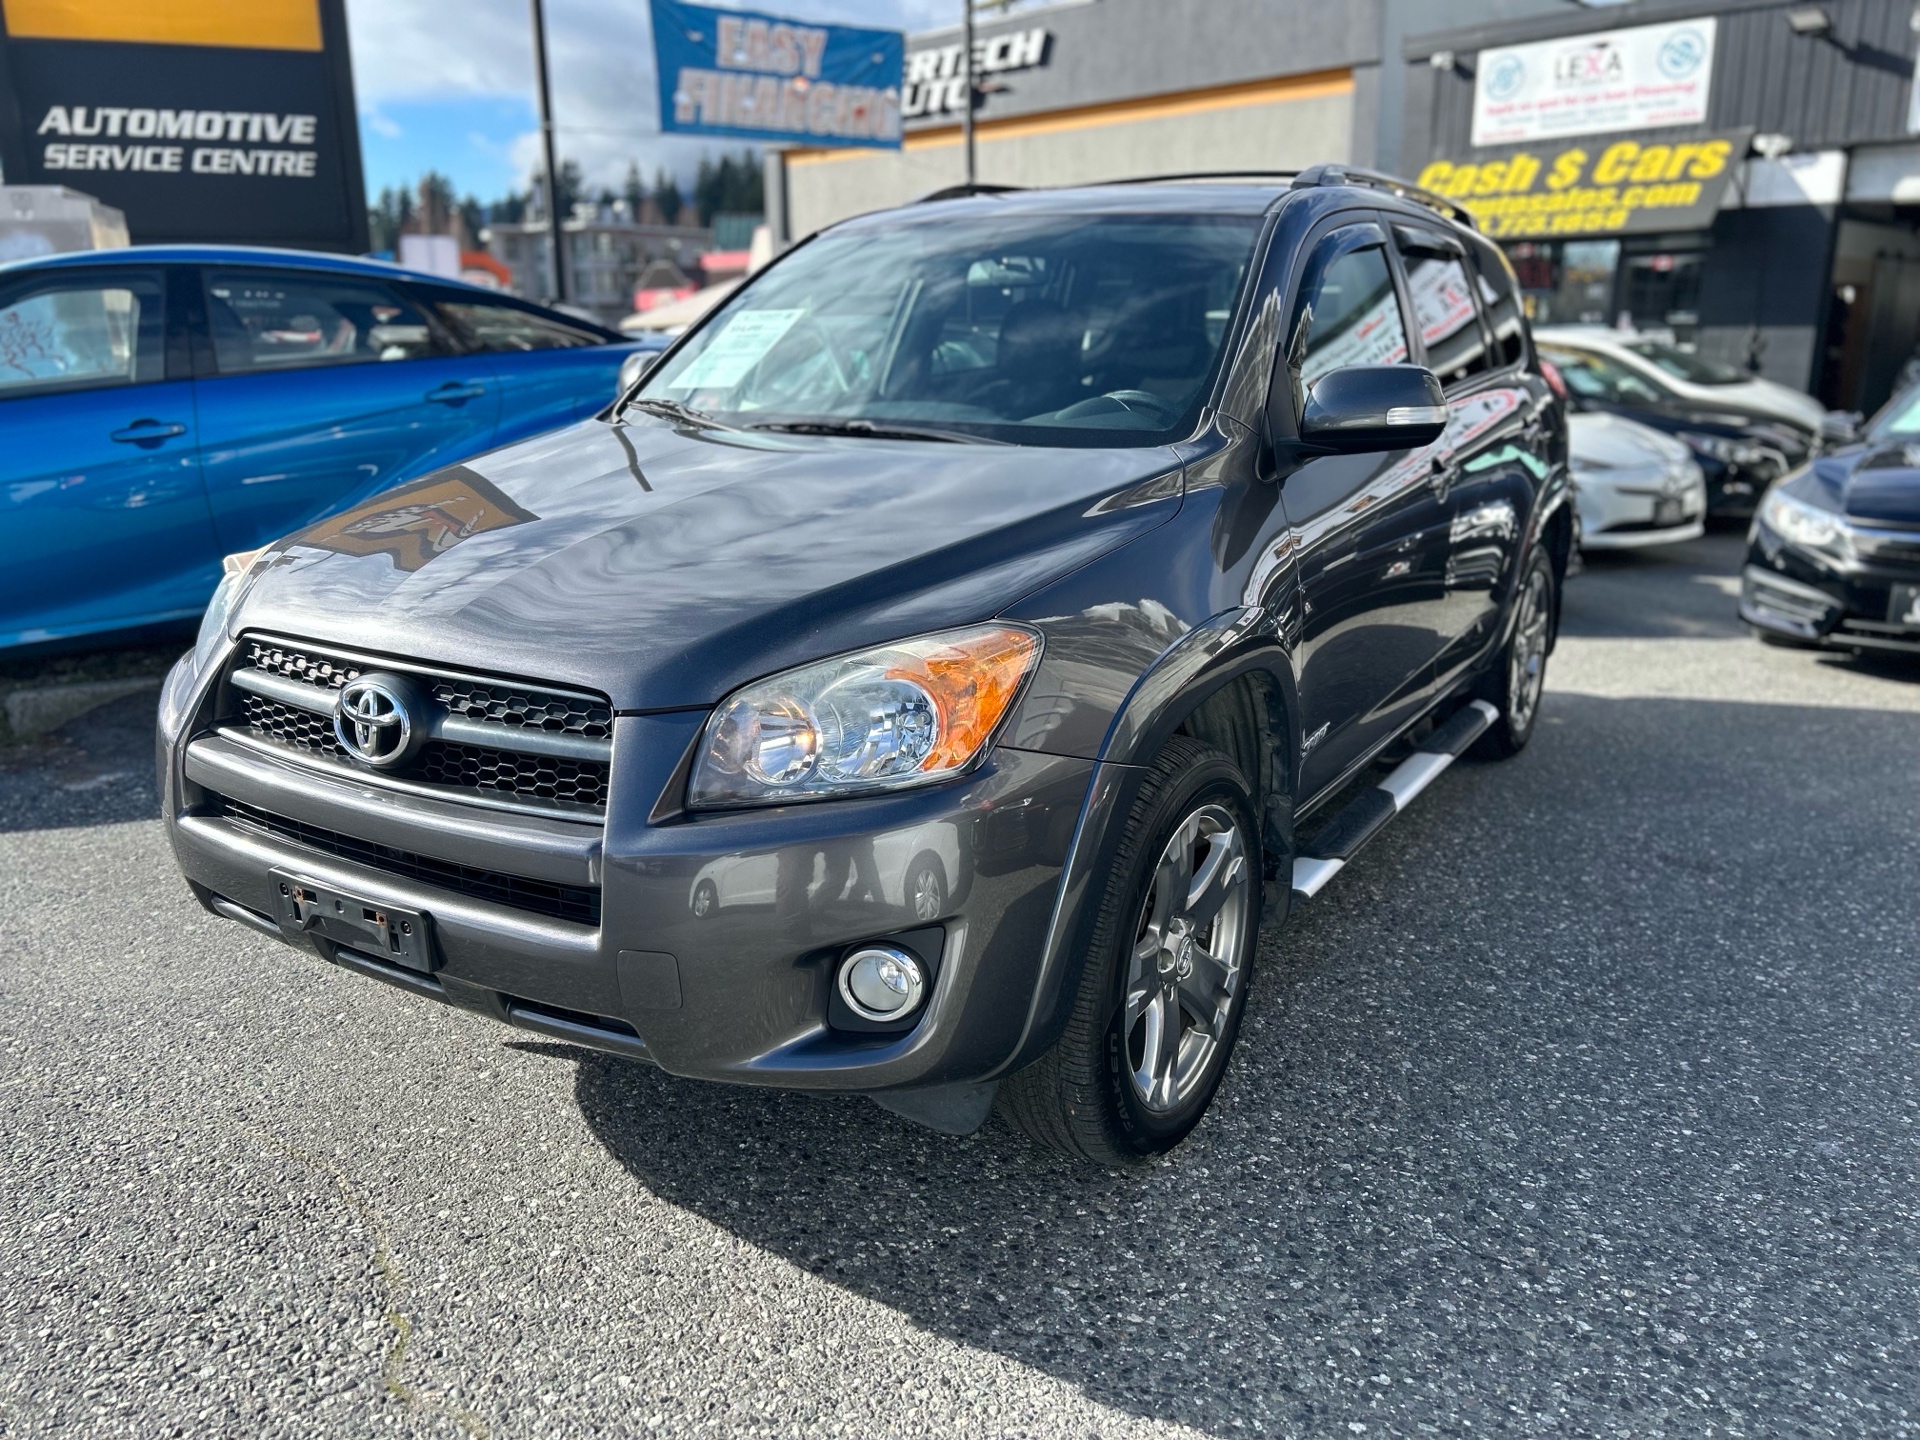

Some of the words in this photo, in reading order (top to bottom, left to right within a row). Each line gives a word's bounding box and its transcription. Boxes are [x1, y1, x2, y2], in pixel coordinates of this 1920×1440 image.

[716, 16, 828, 78] EASY
[904, 29, 1045, 84] RTECH
[1554, 50, 1623, 80] LEXA
[901, 78, 971, 117] UTO
[37, 105, 318, 144] AUTOMOTIVE
[43, 143, 184, 172] SERVICE
[190, 148, 318, 177] CENTRE
[1417, 153, 1542, 196] Cash
[1592, 140, 1732, 183] Cars
